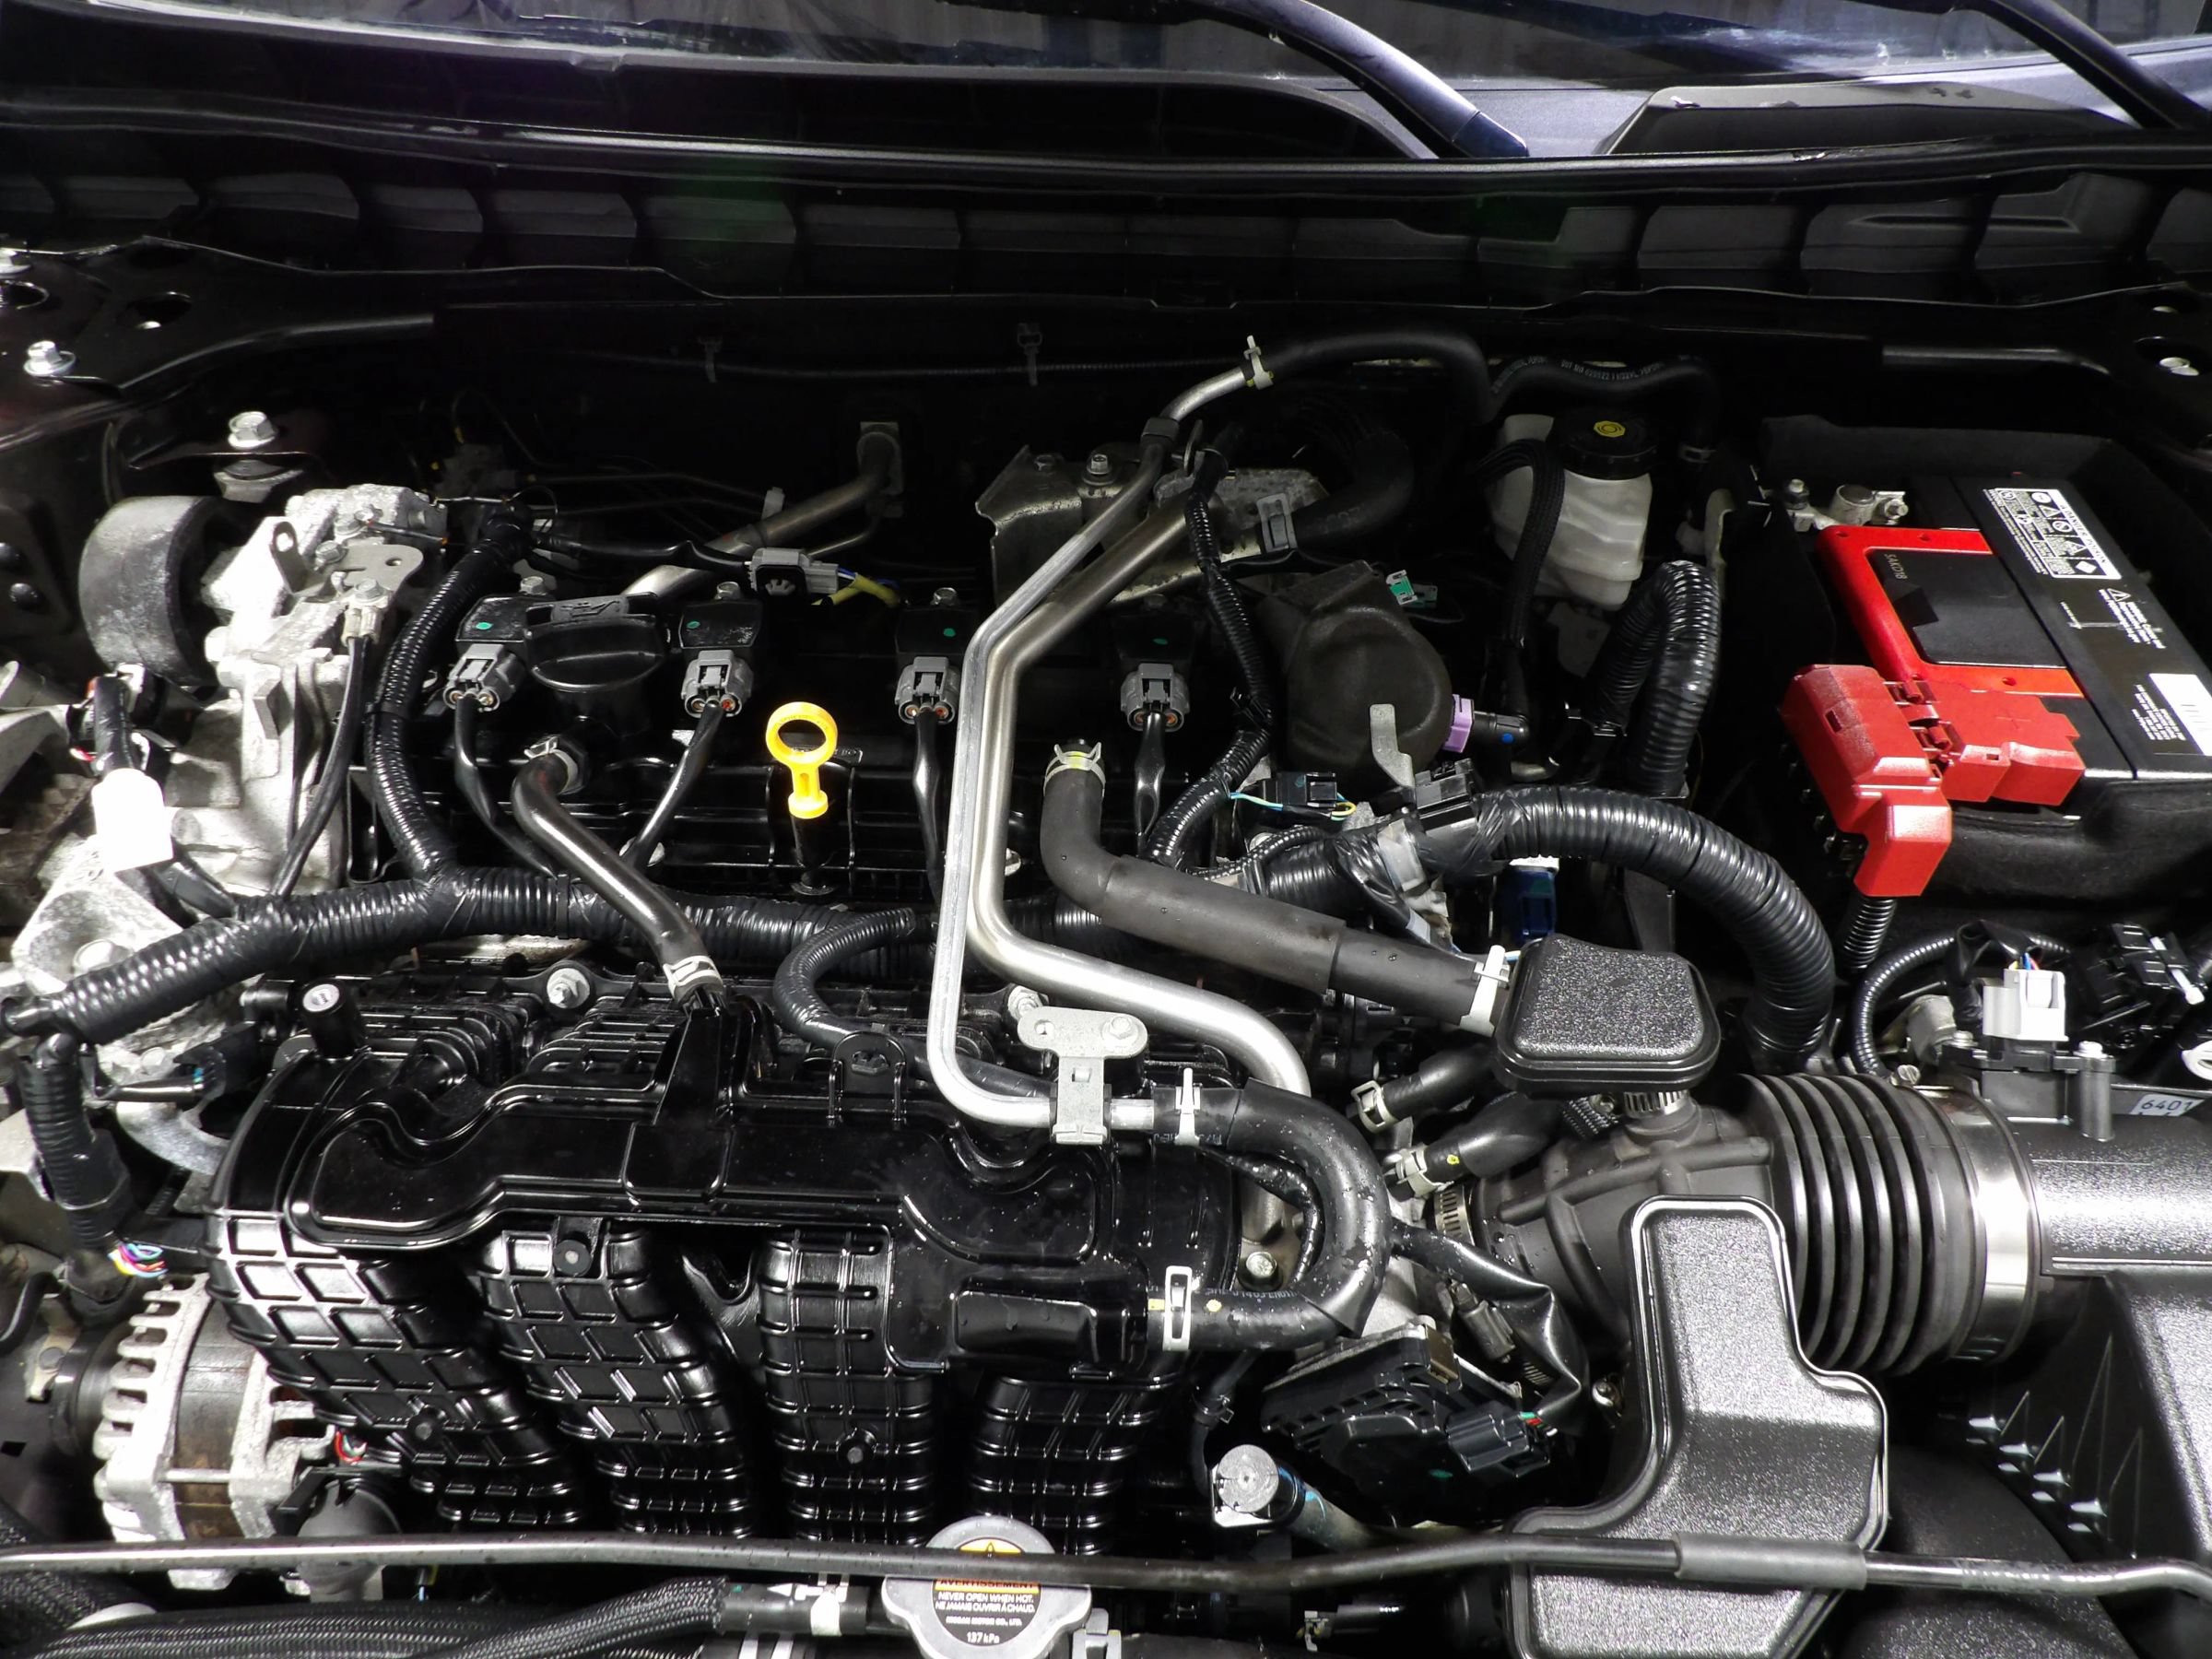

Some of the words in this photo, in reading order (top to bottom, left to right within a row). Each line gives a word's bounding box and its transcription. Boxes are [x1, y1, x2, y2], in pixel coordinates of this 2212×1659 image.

[938, 1591, 965, 1601] NEVER
[966, 1592, 988, 1602] OPEN
[989, 1593, 1015, 1603] WHEN
[1015, 1594, 1034, 1604] HOT.
